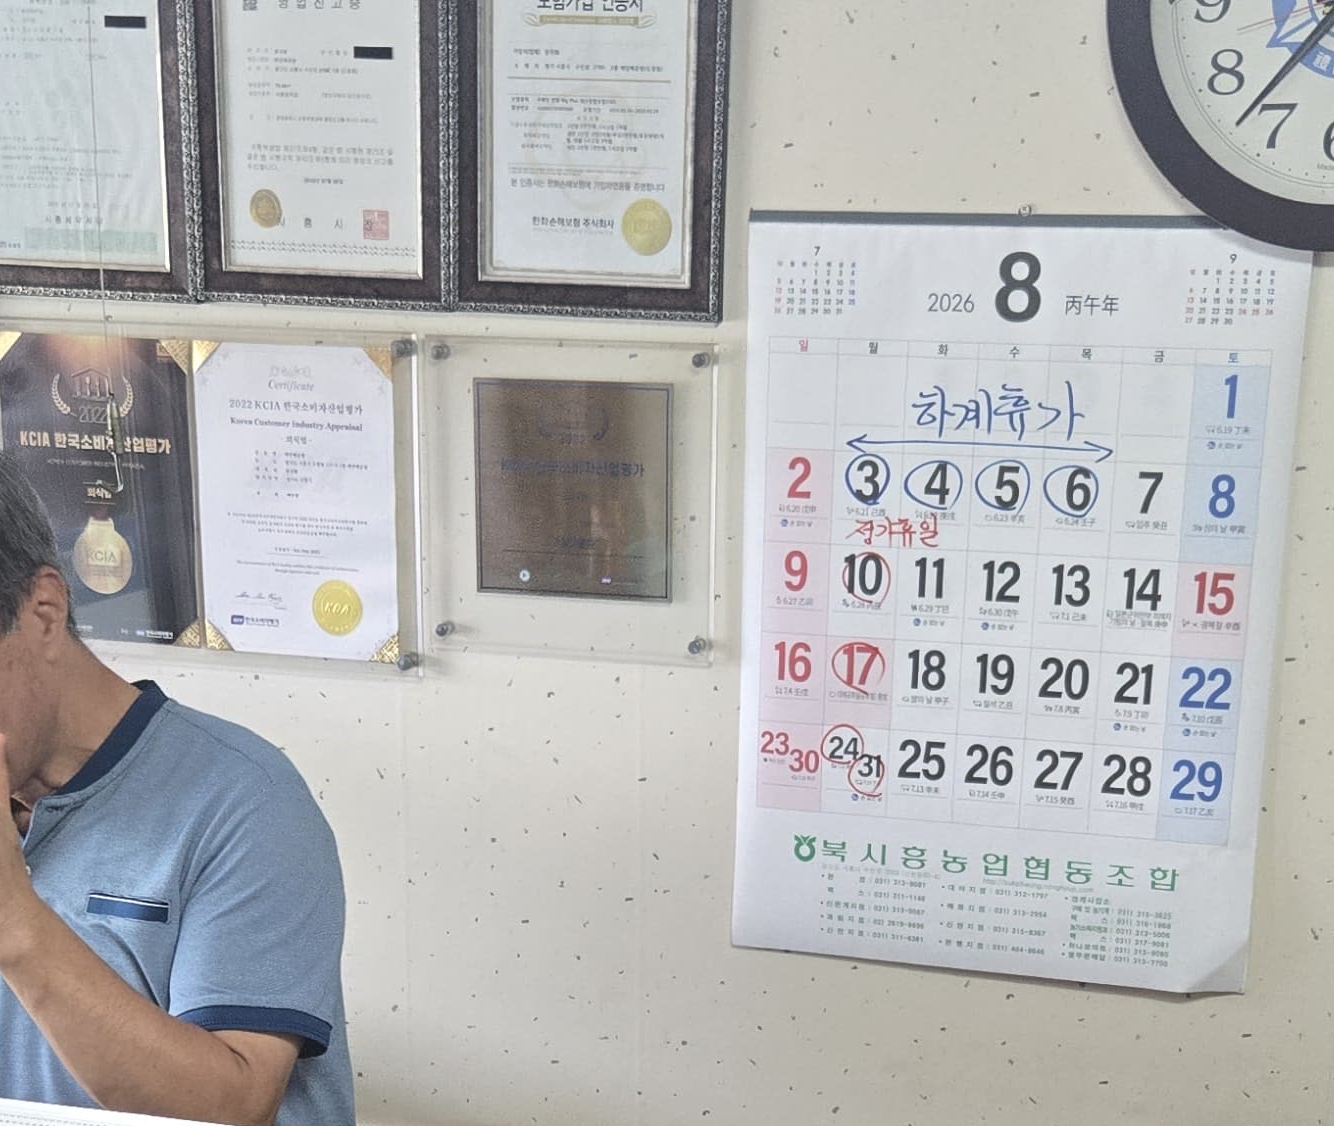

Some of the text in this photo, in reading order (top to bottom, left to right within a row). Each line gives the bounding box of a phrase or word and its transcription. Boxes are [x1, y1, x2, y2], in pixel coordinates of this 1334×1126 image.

[1207, 48, 1245, 95] 8
[1258, 102, 1298, 150] 7
[814, 246, 821, 256] 7
[1229, 253, 1237, 264] 9
[927, 251, 1119, 322] 2026 8 丙午年
[938, 343, 949, 357] 화
[1009, 346, 1020, 359] 수
[1154, 350, 1164, 363] 금
[267, 379, 315, 392] Certificate
[1224, 374, 1239, 419] 1
[230, 416, 363, 432] Korea Customer Industry Appraisal
[911, 380, 1086, 441] 하계휴가
[20, 430, 50, 448] KCIA
[787, 456, 812, 499] 2
[855, 460, 880, 502] 3
[924, 463, 950, 505] 4
[994, 465, 1020, 508] 5
[1066, 466, 1092, 512] 6
[1138, 471, 1164, 514] 7
[1208, 473, 1236, 519] 8
[784, 550, 808, 592] 9
[844, 553, 883, 596] 10
[915, 557, 945, 599] 11
[983, 560, 1021, 603] 12
[1052, 564, 1091, 607] 13
[1123, 568, 1162, 611] 14
[1194, 571, 1235, 616] 15
[774, 641, 812, 682] 16
[842, 644, 879, 686] 17
[908, 649, 946, 691] 18
[976, 653, 1015, 695] 19
[1038, 657, 1090, 701] 20
[1114, 662, 1154, 705] 21
[1178, 666, 1232, 711] 22
[760, 730, 789, 756] 23
[788, 749, 819, 774] 30
[828, 736, 859, 761] 24
[897, 739, 946, 781] 25
[857, 754, 882, 778] 31
[964, 743, 1014, 786] 26
[1034, 749, 1084, 791] 27
[1100, 754, 1152, 798] 28
[1169, 759, 1223, 803] 29
[820, 838, 1180, 892] 북시흥농업협동조합
